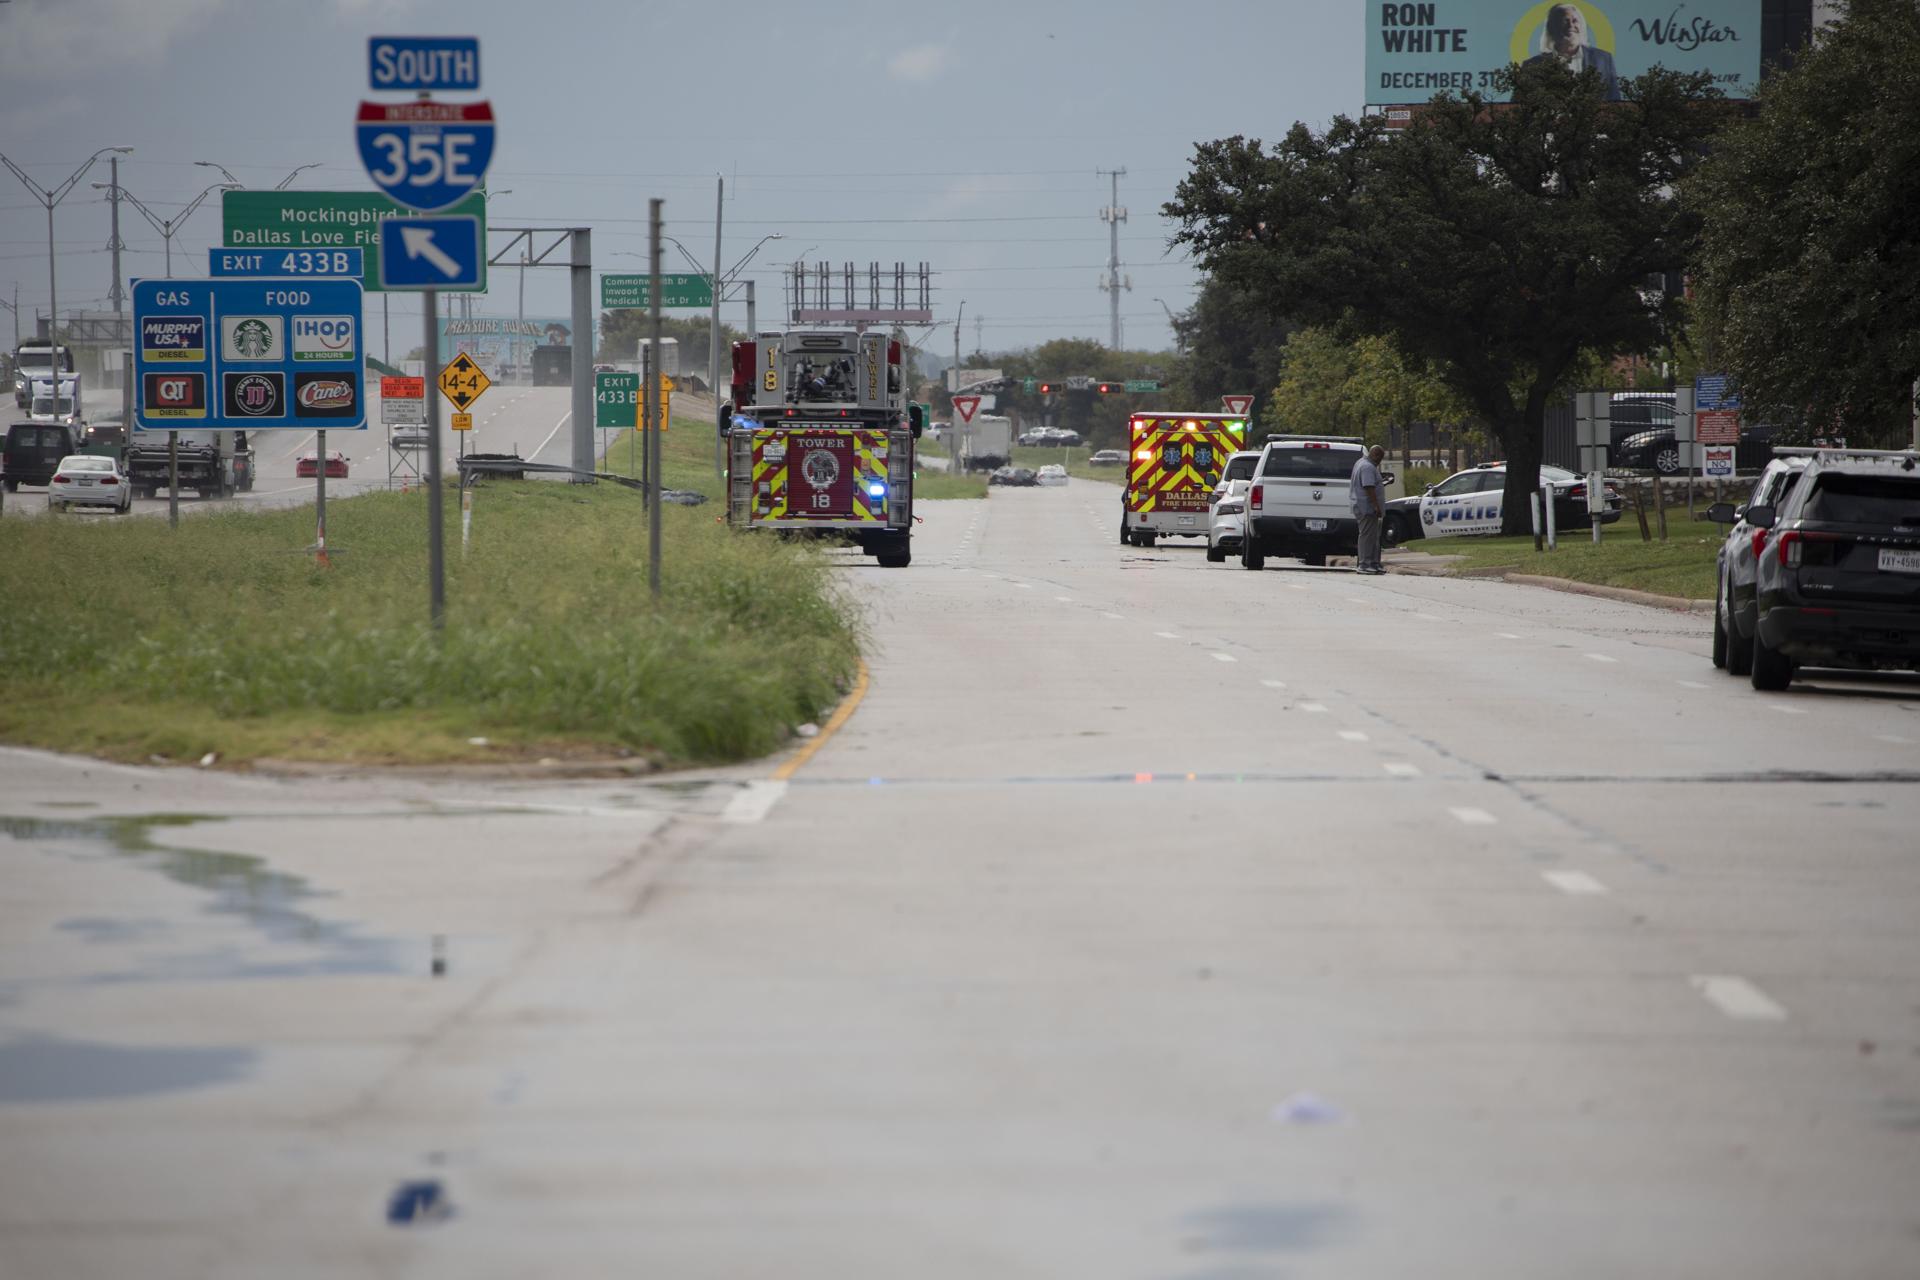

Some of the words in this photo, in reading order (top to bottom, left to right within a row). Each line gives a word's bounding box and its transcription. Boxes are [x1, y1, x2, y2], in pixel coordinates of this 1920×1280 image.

[1382, 3, 1435, 26] RON
[1628, 8, 1741, 51] WinStar
[1382, 29, 1467, 52] WHITE
[374, 44, 474, 83] SOUTH
[1381, 72, 1473, 88] DECEMBER
[384, 105, 464, 121] INTERSTATE
[371, 133, 477, 186] 35E
[281, 208, 397, 226] Mockingbird
[233, 229, 291, 243] Dallas
[301, 230, 344, 244] Love
[355, 230, 381, 244] Fie
[222, 255, 263, 270] EXIT
[281, 252, 349, 273] 433B
[605, 278, 674, 286] Commonwth
[156, 291, 190, 306] GAS
[265, 291, 310, 306] FOOD
[605, 297, 639, 305] Medical
[145, 324, 200, 334] MURPHY
[155, 335, 180, 344] USA
[866, 338, 880, 400] TOWER
[604, 378, 631, 387] EXIT
[160, 381, 187, 400] QT
[301, 381, 351, 407] Cane's
[797, 439, 846, 448] TOWER
[1711, 460, 1727, 468] NO
[811, 495, 831, 508] 18
[1166, 492, 1208, 500] DALLAS
